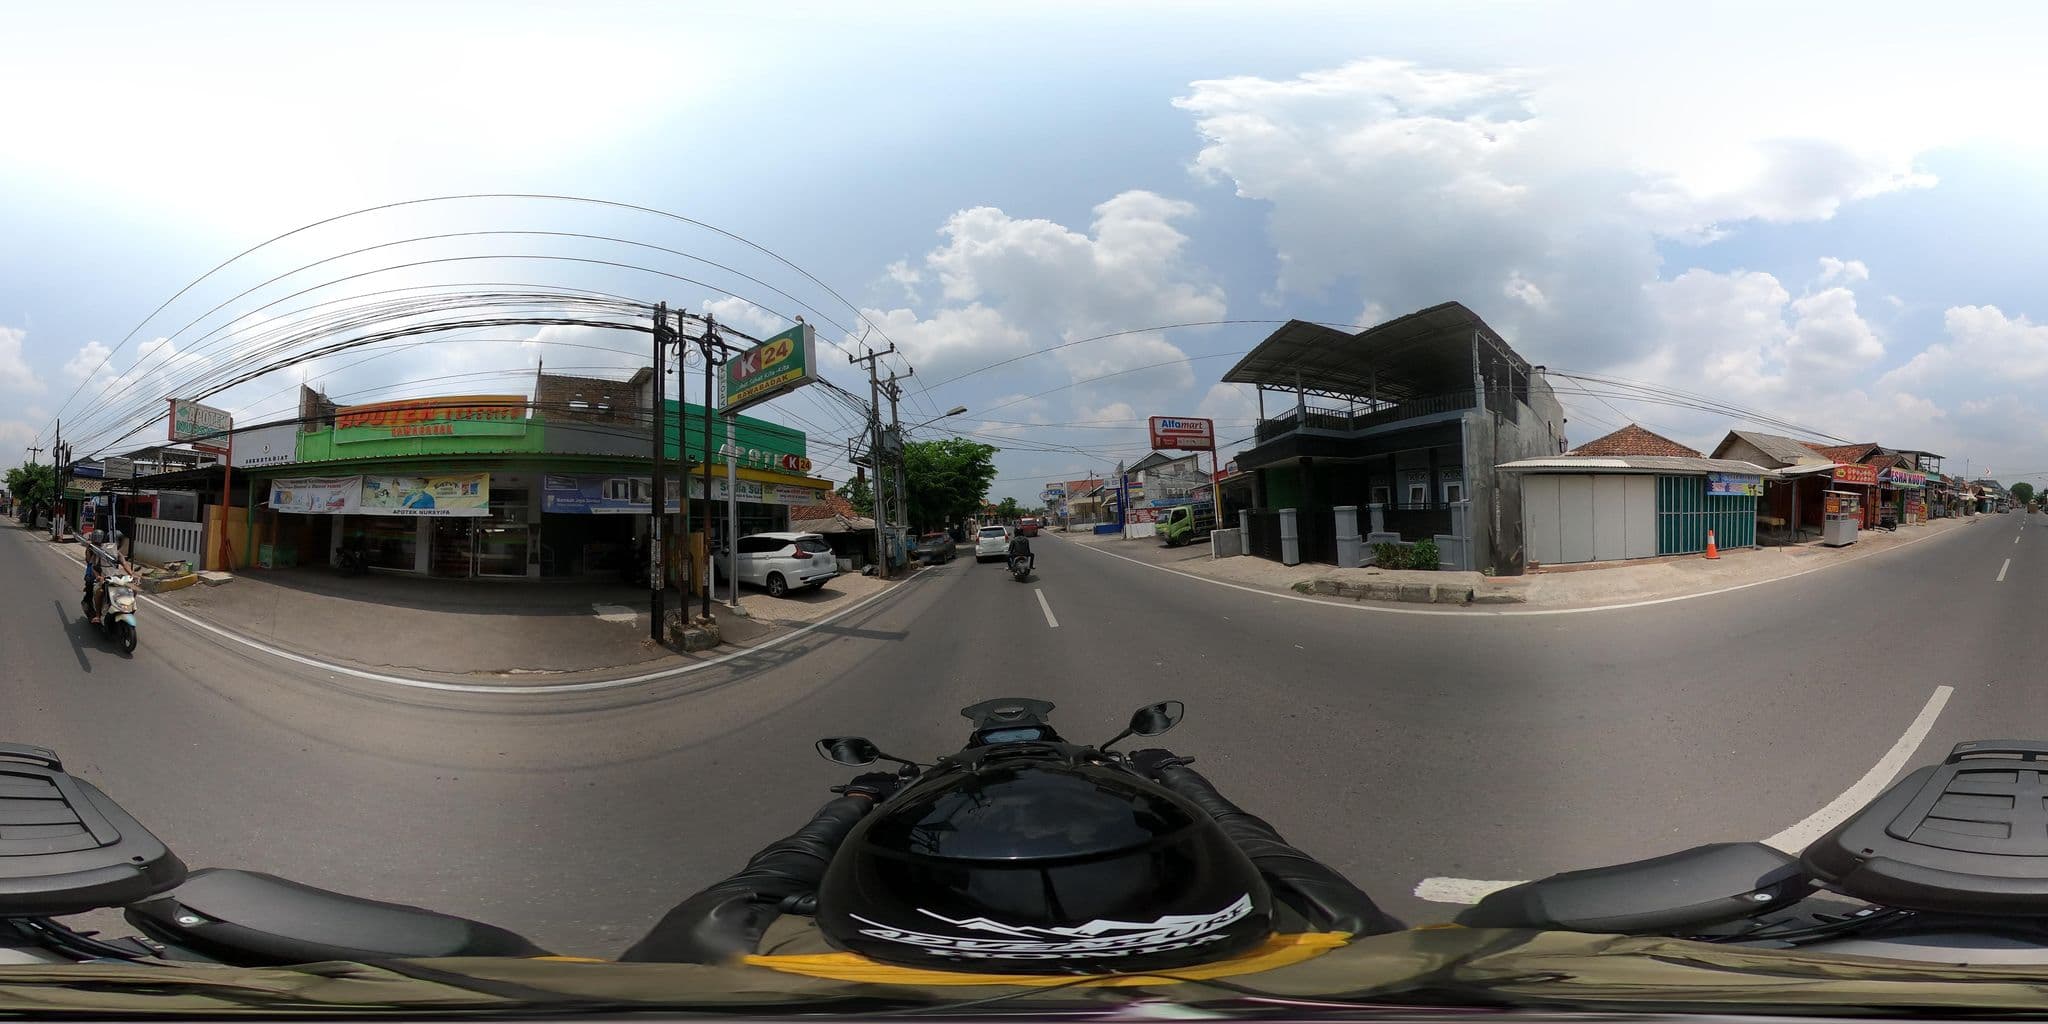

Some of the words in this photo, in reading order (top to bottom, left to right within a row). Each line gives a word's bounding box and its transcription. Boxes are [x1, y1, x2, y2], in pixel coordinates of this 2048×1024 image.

[741, 353, 756, 378] K
[764, 341, 789, 365] 24
[736, 374, 789, 400] RAWABADAK
[188, 405, 229, 430] APOTEK
[1161, 419, 1203, 430] Alfamart
[800, 460, 809, 469] 24
[926, 934, 1231, 960] HONDA
